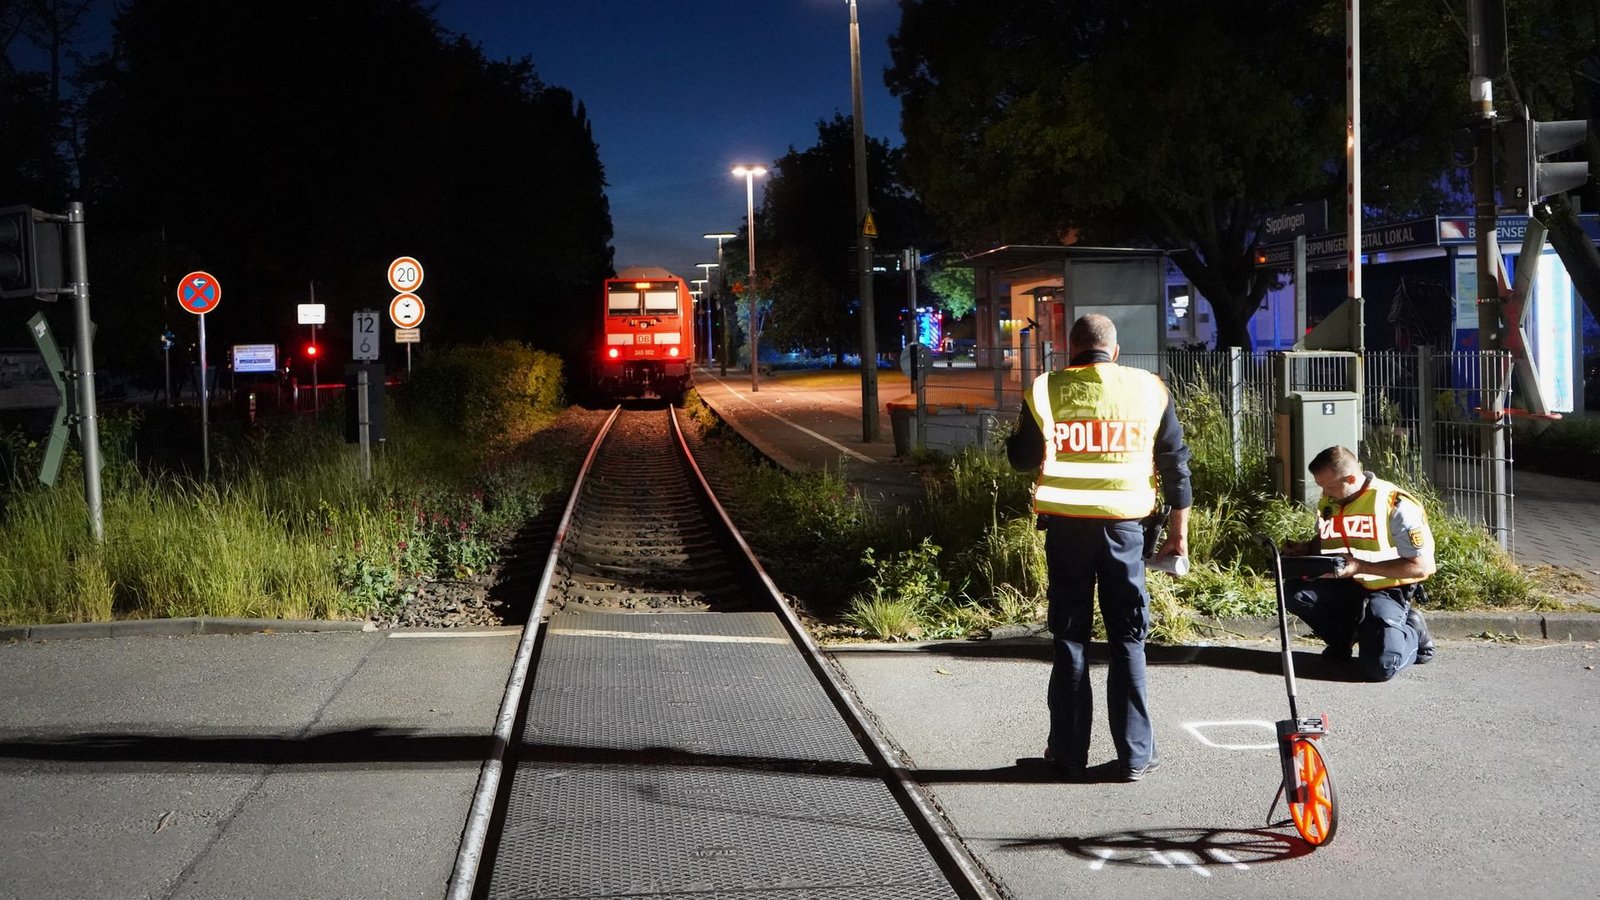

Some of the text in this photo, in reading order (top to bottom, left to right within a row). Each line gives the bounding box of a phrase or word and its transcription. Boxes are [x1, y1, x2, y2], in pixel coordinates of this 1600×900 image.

[1516, 187, 1523, 198] 2
[1266, 213, 1305, 235] Sipplingen
[1385, 227, 1414, 245] LOKAL
[397, 267, 415, 282] 20
[357, 316, 374, 333] 12
[360, 336, 371, 353] 6
[638, 335, 650, 343] DB
[1325, 404, 1333, 414] 2
